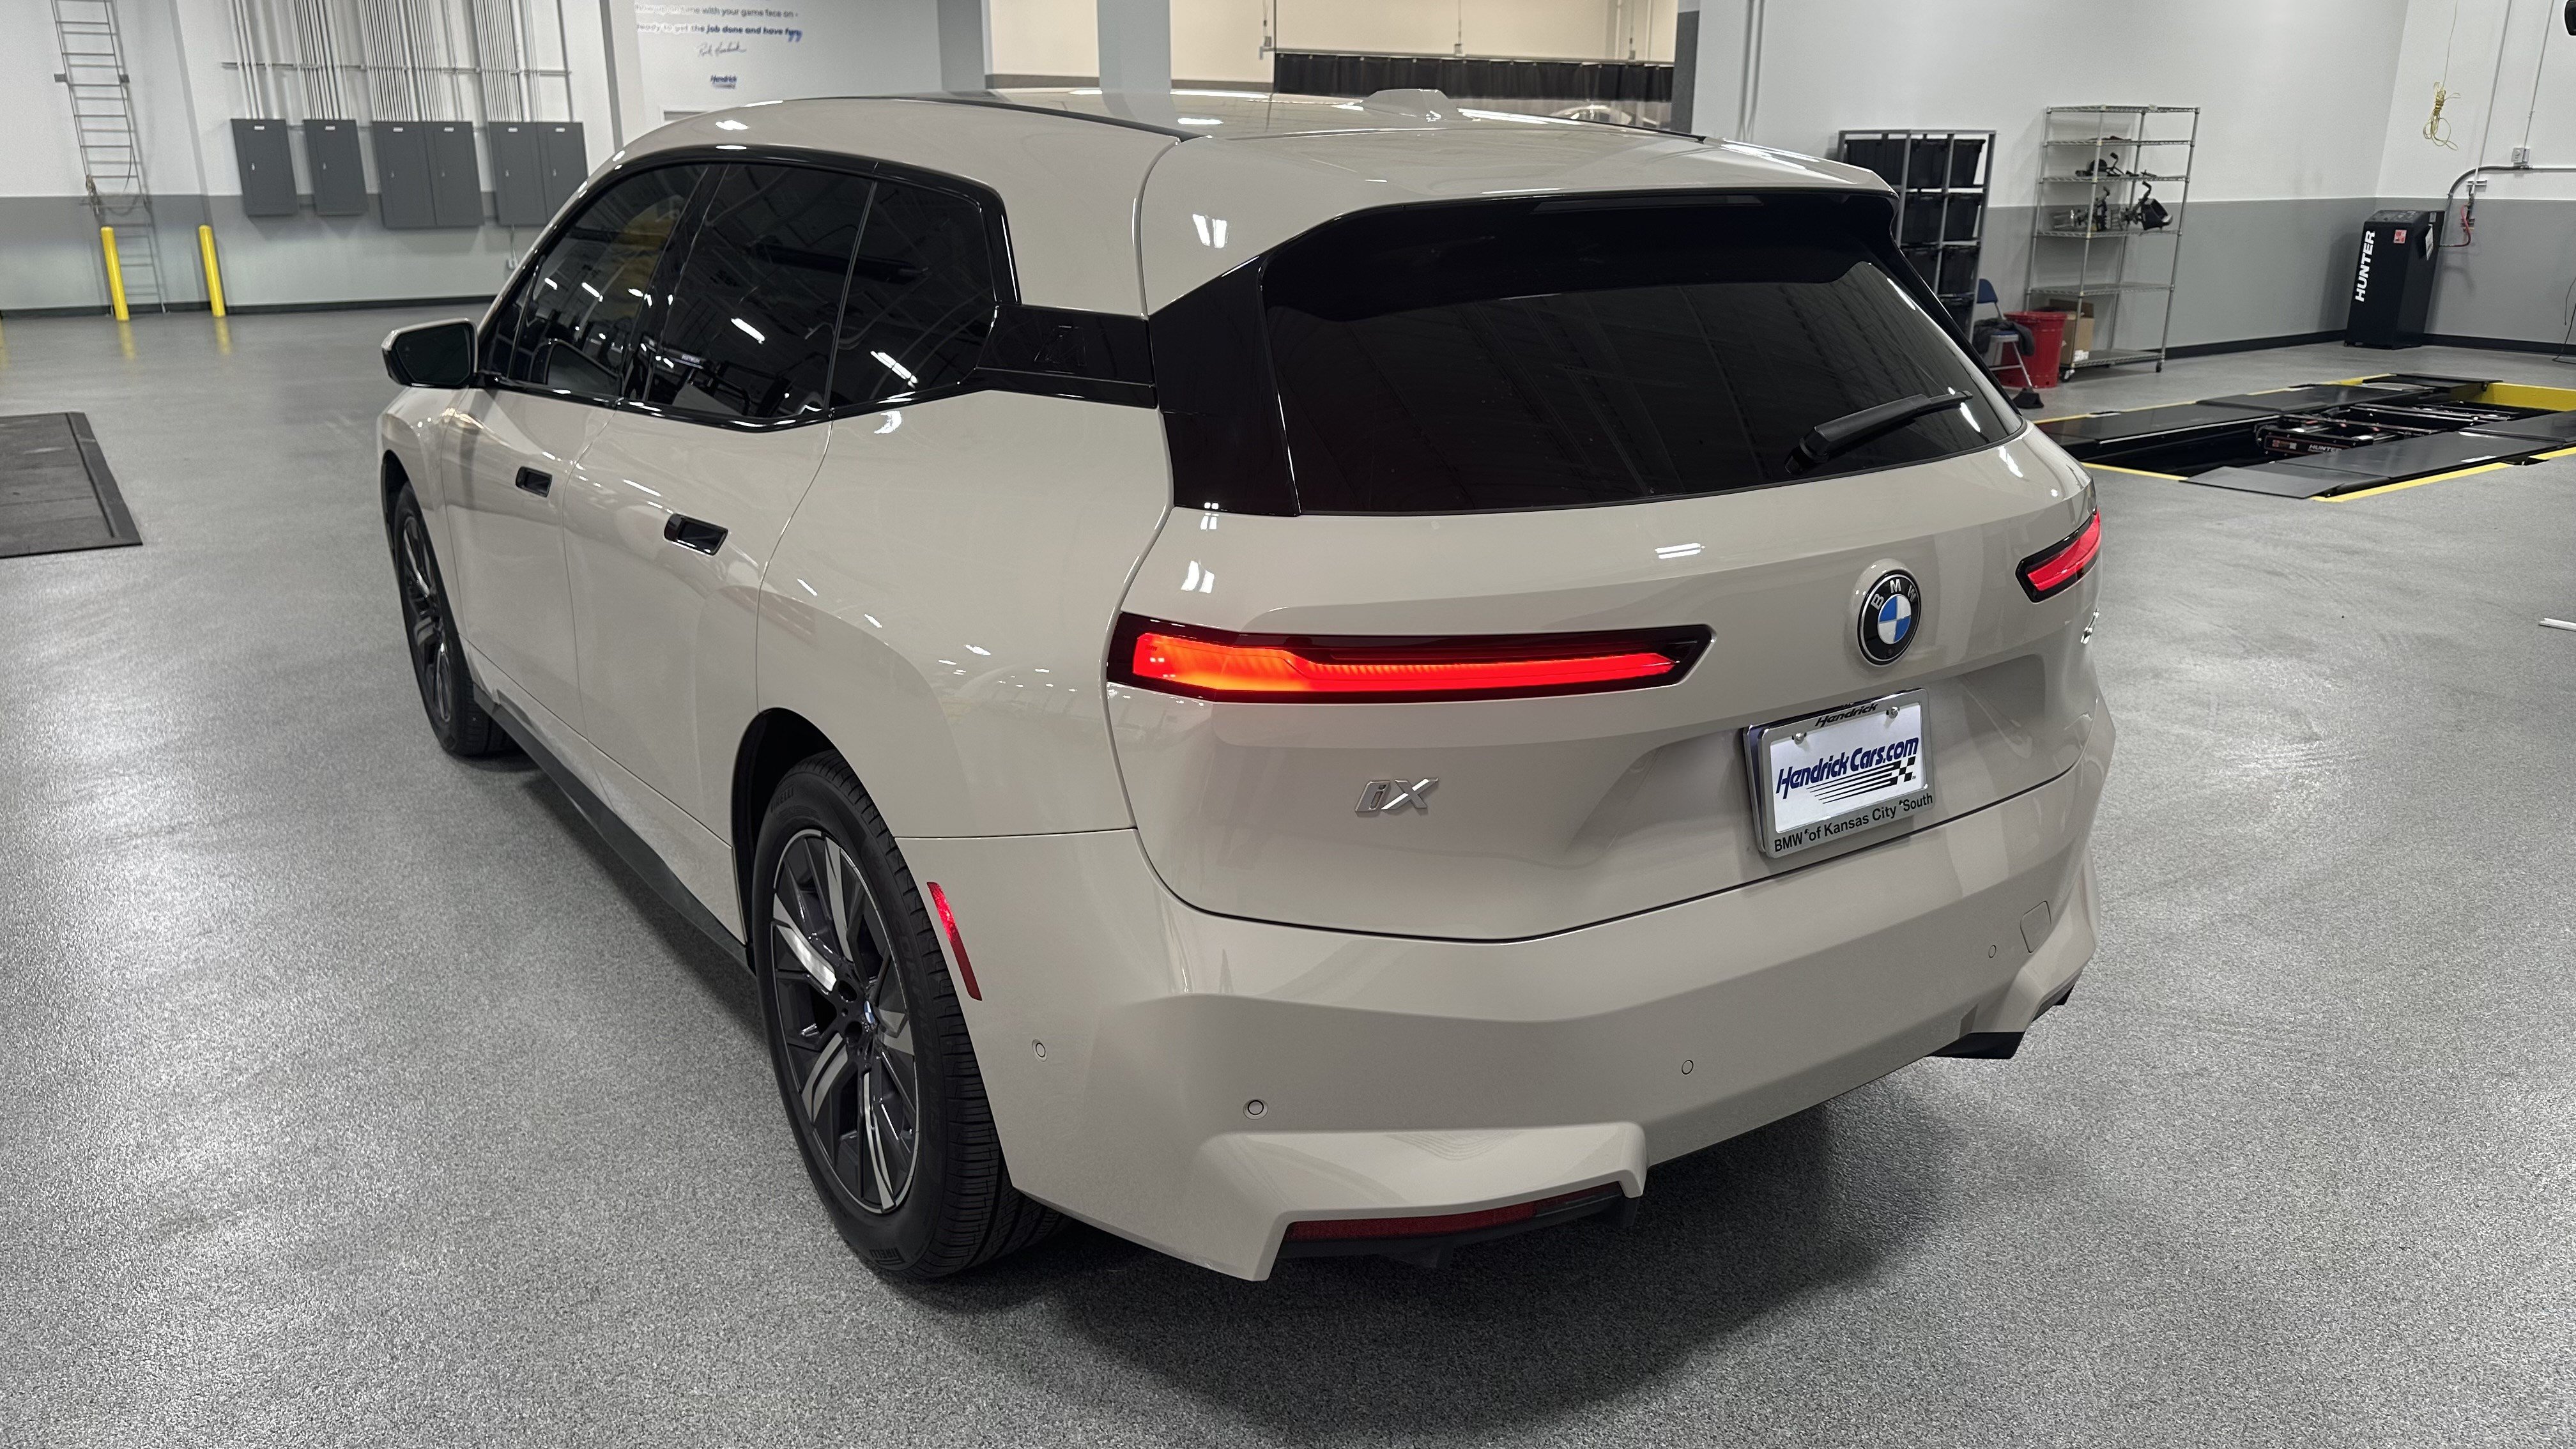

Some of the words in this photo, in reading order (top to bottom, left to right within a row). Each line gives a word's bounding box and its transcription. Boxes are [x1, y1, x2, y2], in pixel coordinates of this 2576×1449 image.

[721, 8, 739, 17] your
[740, 9, 764, 18] game
[705, 24, 720, 34] job
[2355, 231, 2375, 303] HUNTER
[1871, 579, 1917, 610] BMW
[1815, 703, 1878, 727] Hendrick
[1354, 777, 1439, 813] iX
[1774, 833, 1804, 852] BMW
[1809, 829, 1821, 841] of
[1824, 815, 1869, 837] Kansas
[1872, 806, 1897, 822] City
[1903, 792, 1933, 812] South
